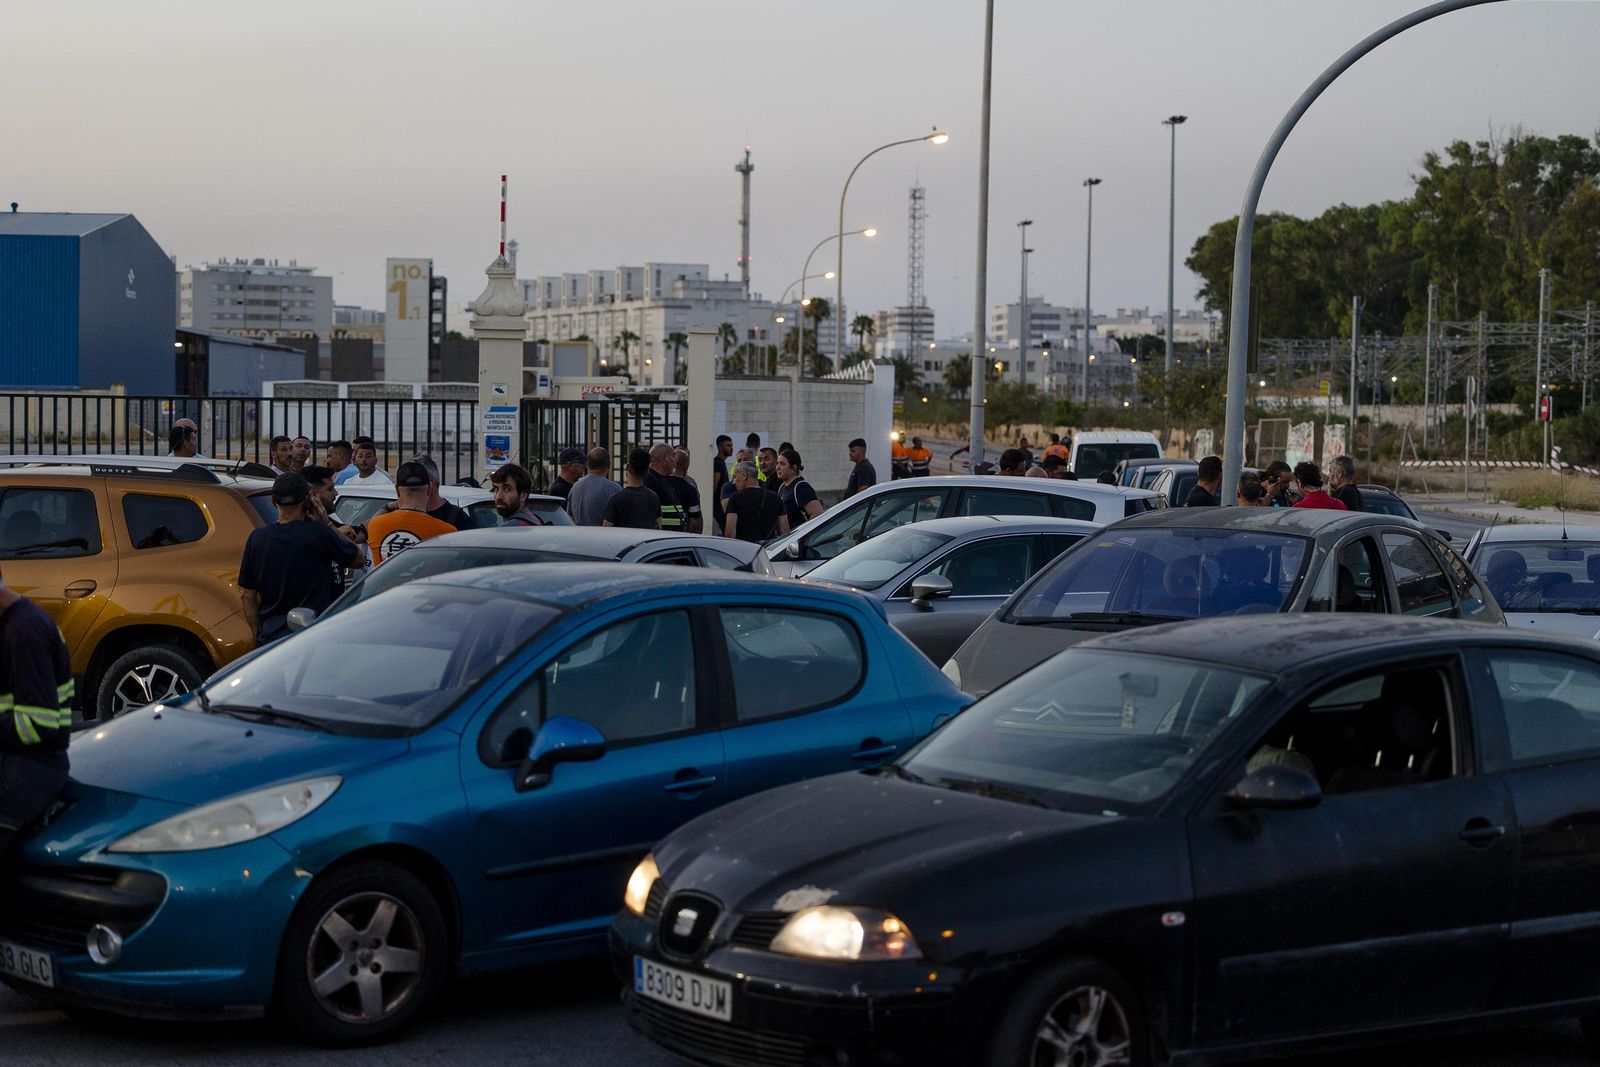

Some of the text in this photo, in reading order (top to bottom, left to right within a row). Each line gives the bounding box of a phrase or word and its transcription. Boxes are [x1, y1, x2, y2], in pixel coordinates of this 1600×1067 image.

[392, 264, 426, 280] no.
[19, 950, 50, 982] GLC
[646, 965, 727, 1015] 8309 DJM
